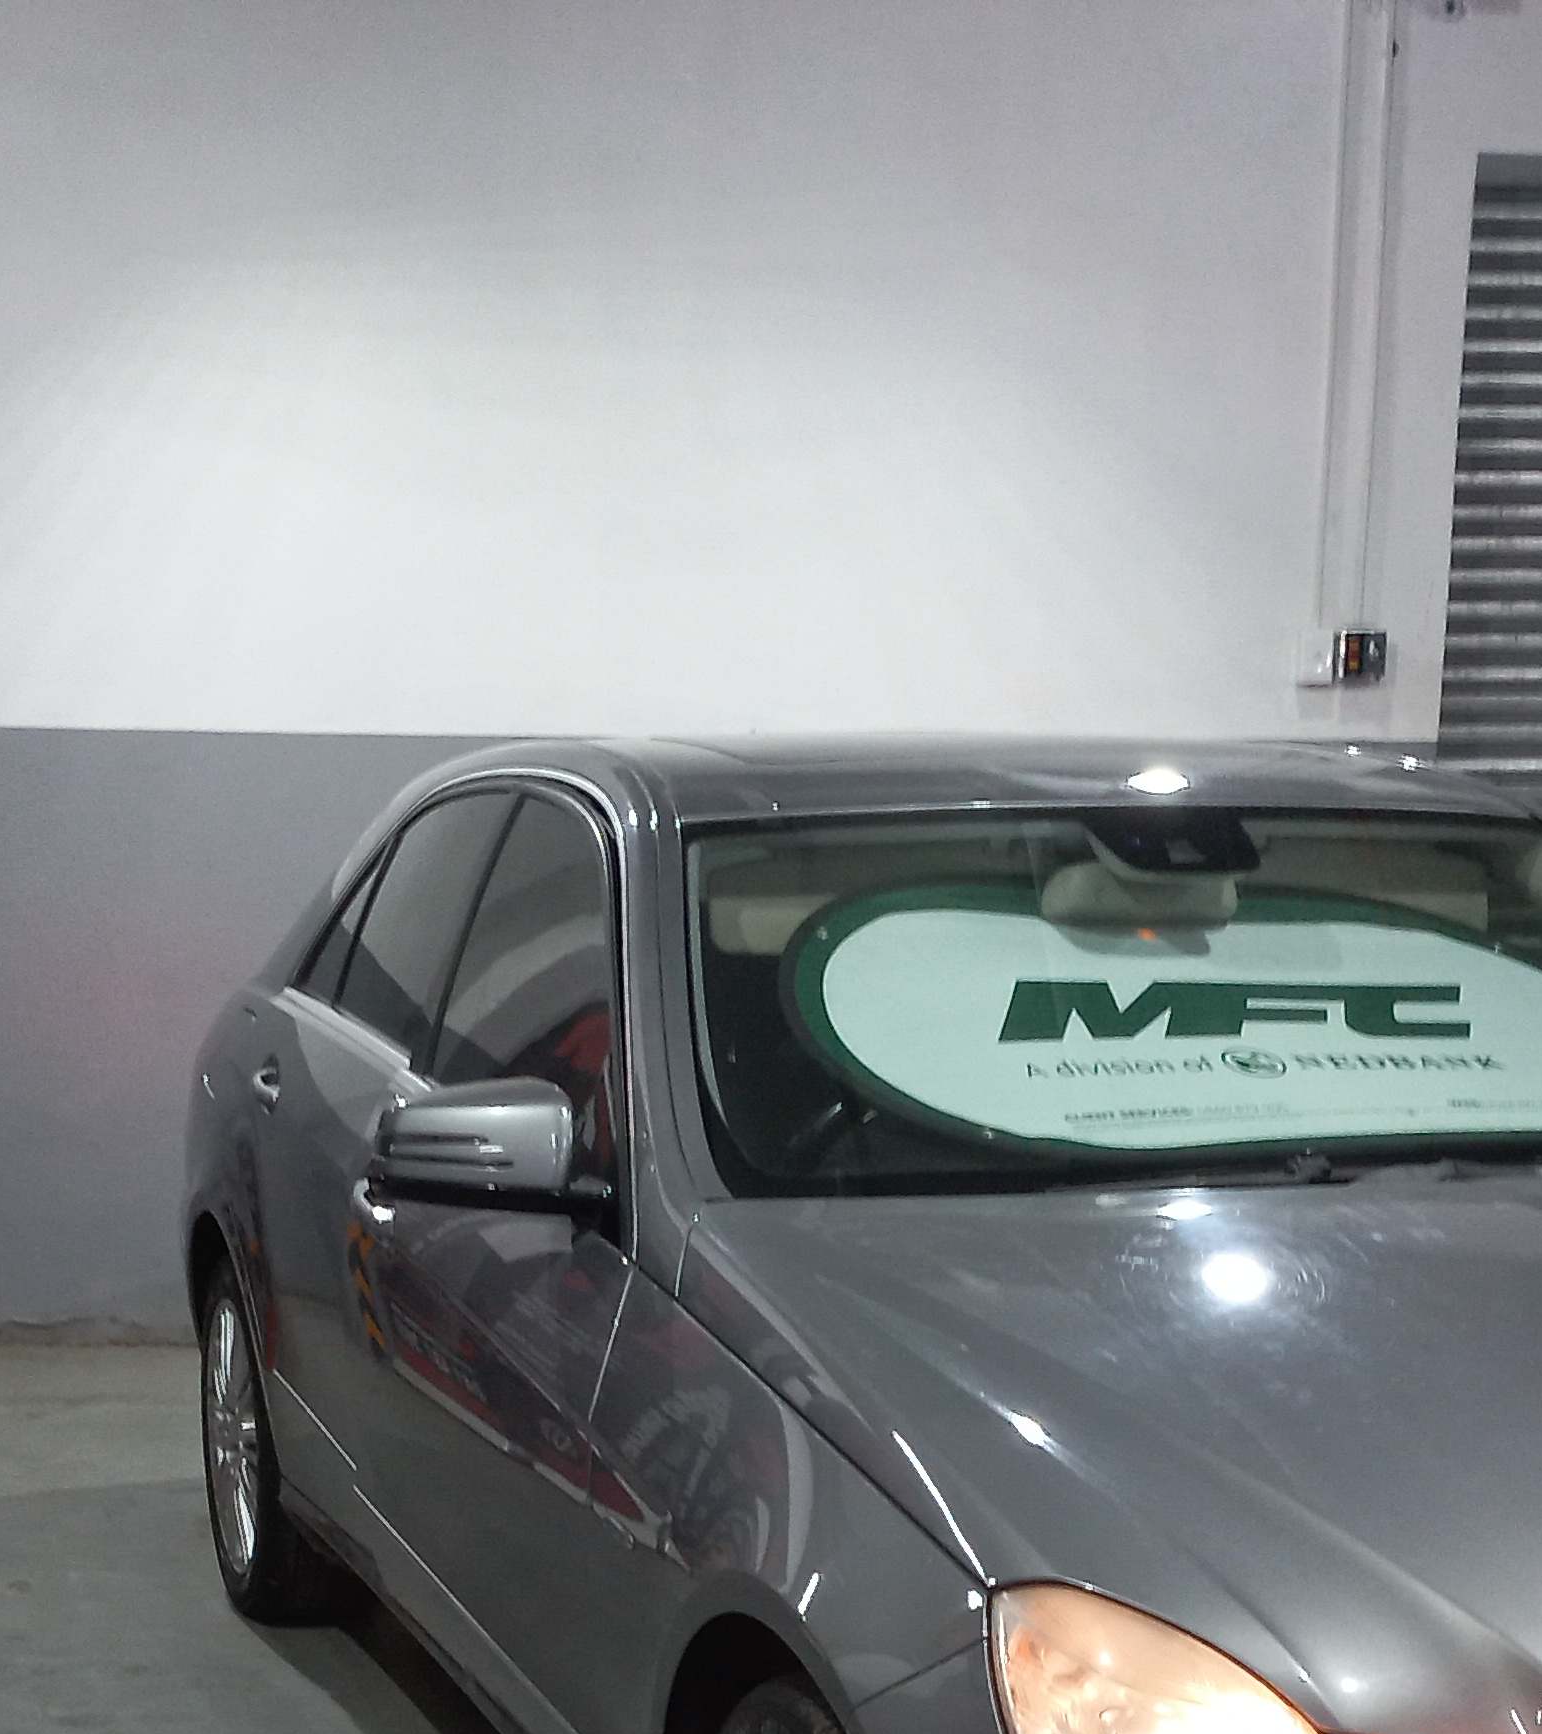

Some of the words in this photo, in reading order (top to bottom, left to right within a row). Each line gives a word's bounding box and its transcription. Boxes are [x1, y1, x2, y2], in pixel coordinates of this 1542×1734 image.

[998, 980, 1471, 1041] MFC
[1056, 1058, 1176, 1078] division
[1294, 1054, 1507, 1071] NEDBANK
